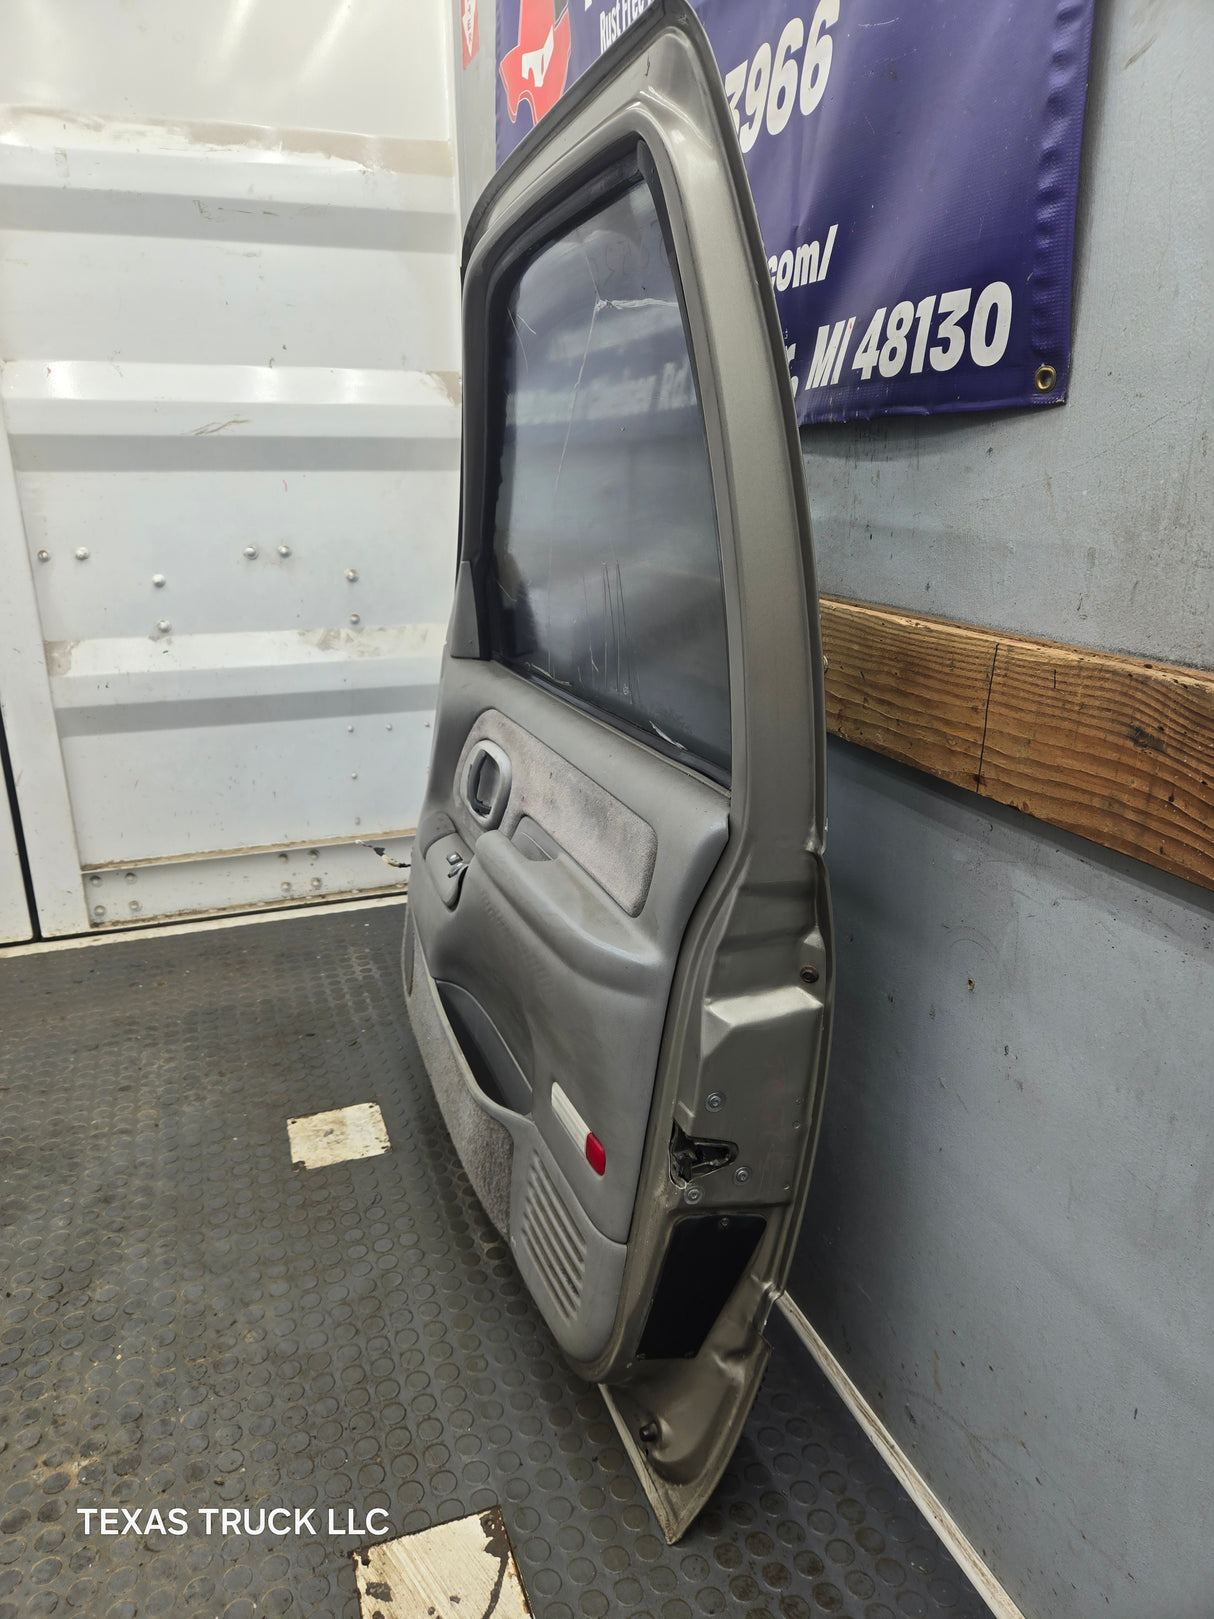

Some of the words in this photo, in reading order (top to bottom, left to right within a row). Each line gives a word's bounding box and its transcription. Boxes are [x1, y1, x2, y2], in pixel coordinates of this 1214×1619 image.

[600, 0, 621, 55] Rust
[804, 316, 857, 391] MI
[851, 281, 1012, 380] 48130
